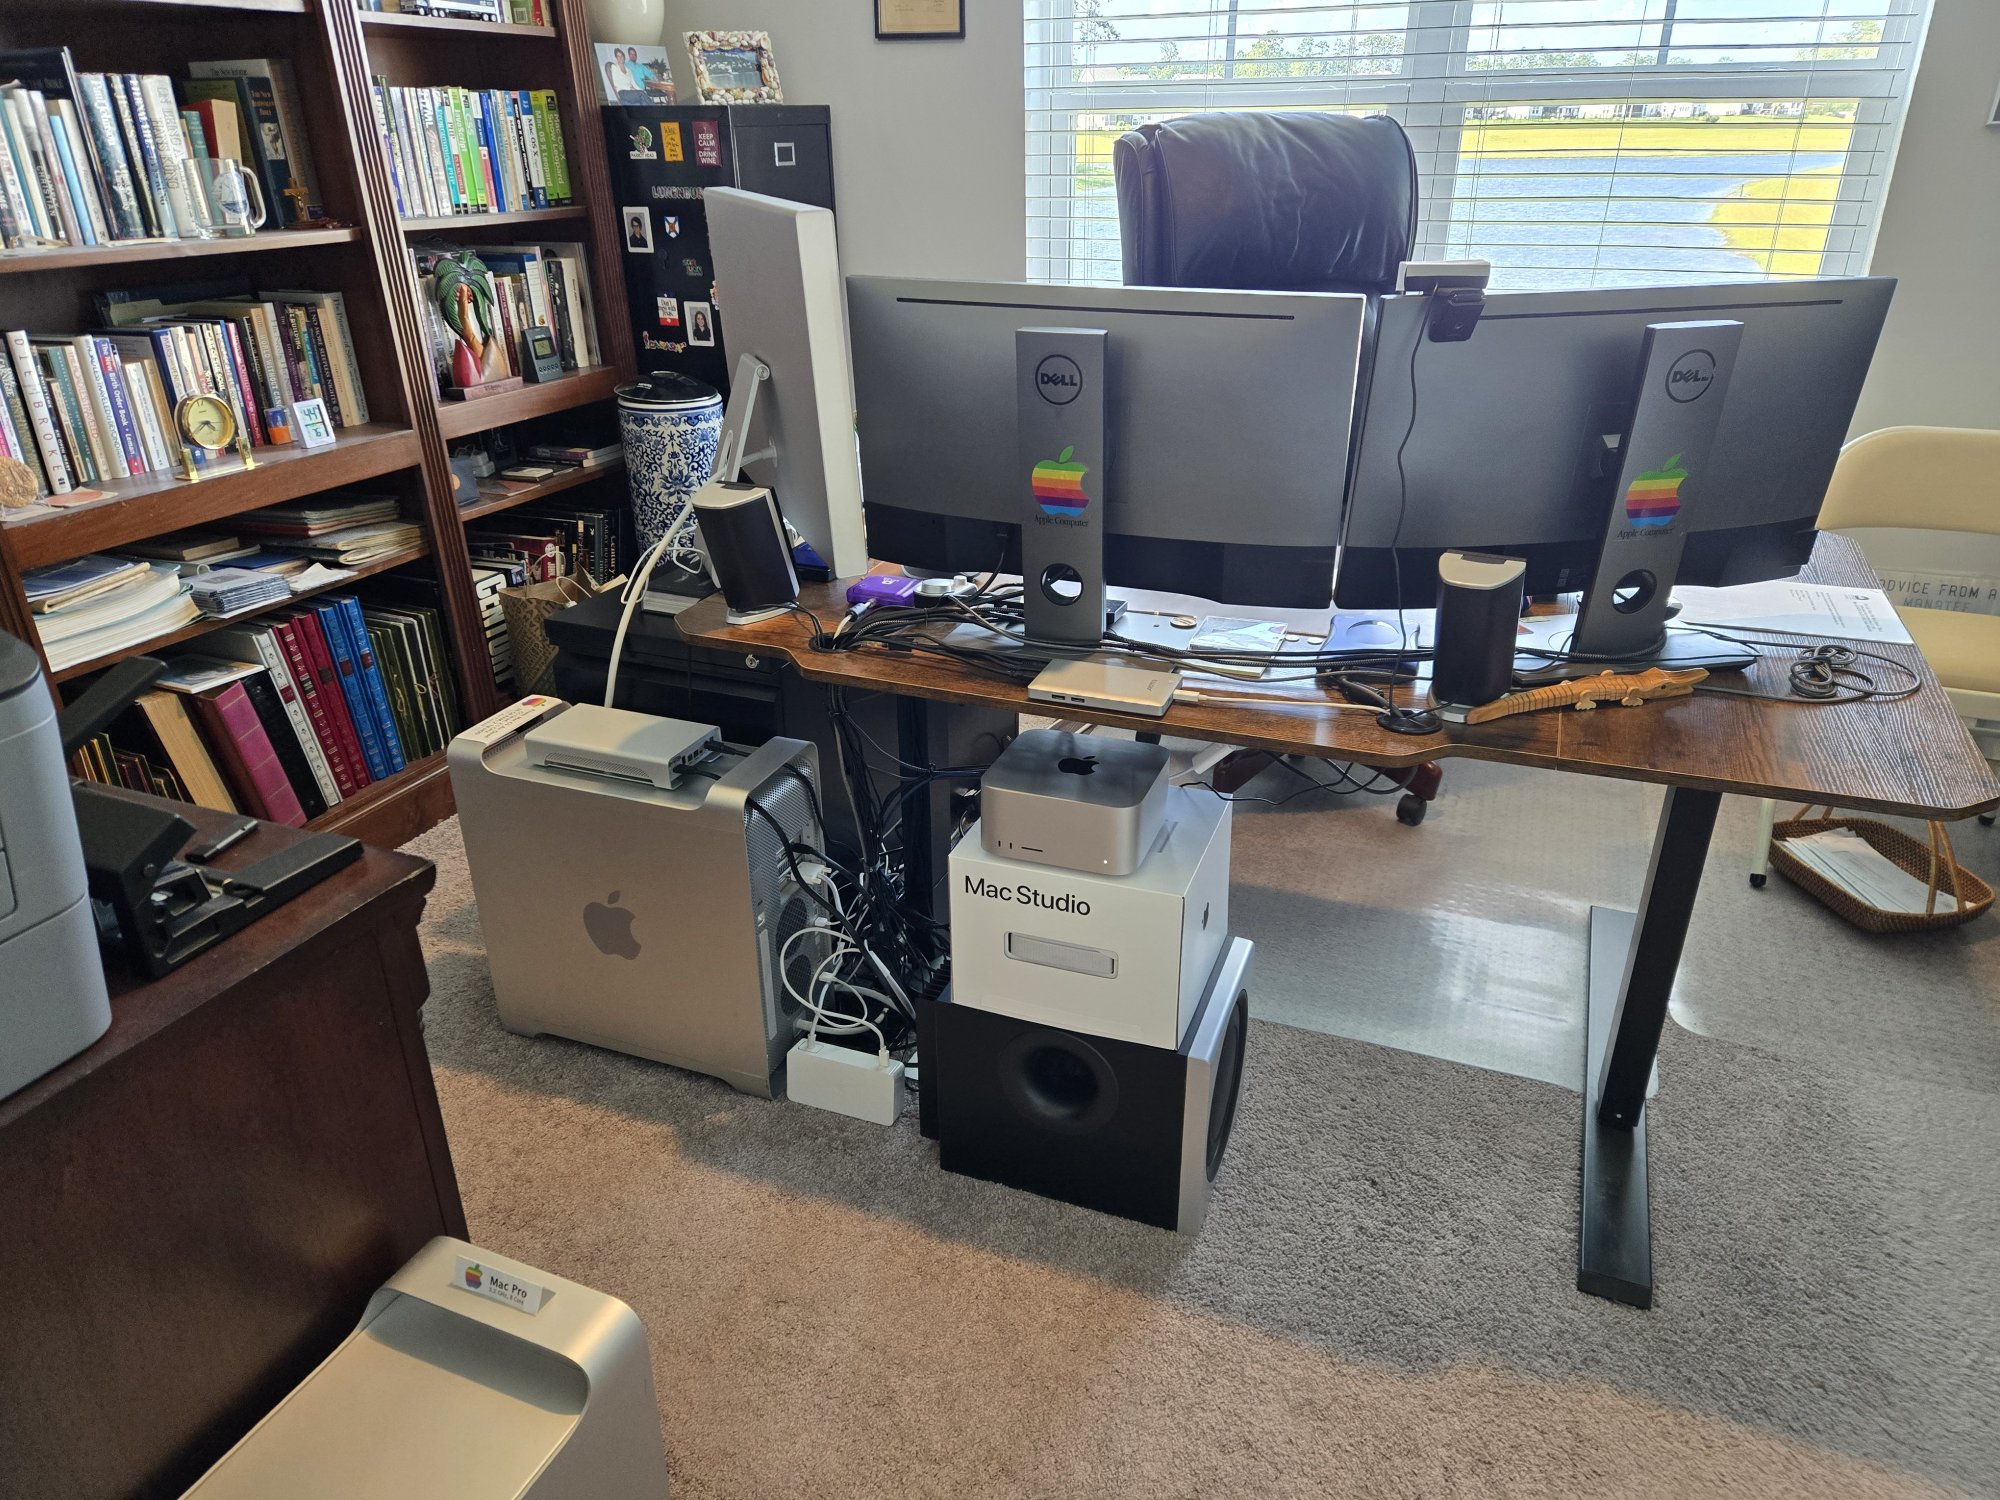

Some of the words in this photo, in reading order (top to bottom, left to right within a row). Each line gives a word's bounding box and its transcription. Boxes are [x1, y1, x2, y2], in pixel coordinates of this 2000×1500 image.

[90, 79, 106, 103] Paul
[94, 101, 116, 146] Johnson
[375, 95, 389, 136] UNIX
[466, 113, 475, 136] CSS
[534, 110, 543, 129] Mac
[553, 114, 562, 134] Mac
[447, 122, 456, 140] PHP
[454, 109, 468, 152] JavaScript
[540, 130, 546, 143] OS
[437, 109, 451, 166] Programming
[447, 168, 456, 185] PHP
[512, 136, 517, 146] OS
[530, 137, 537, 149] OS
[548, 114, 557, 142] Snow
[553, 144, 565, 184] Leopard
[558, 136, 564, 149] OS
[698, 139, 715, 147] CALM
[560, 152, 566, 161] X
[698, 150, 717, 158] DRINK
[700, 157, 717, 165] WINE
[542, 153, 553, 187] Leopard
[35, 165, 56, 216] CHRISTIAN
[652, 186, 705, 200] LUNENBUR
[333, 298, 341, 310] The
[288, 309, 301, 350] REBUILDING
[311, 314, 318, 326] NO
[336, 312, 347, 338] Promise
[314, 327, 323, 346] MORE
[344, 340, 350, 348] of
[101, 342, 109, 355] The
[105, 356, 114, 372] New
[162, 337, 172, 358] MARS
[171, 367, 182, 389] VENUS
[319, 348, 330, 378] SLEEPLESS
[345, 349, 354, 369] Sleep
[0, 358, 15, 397] CARNEGIE
[109, 372, 119, 389] Birth
[260, 335, 270, 358] WORLD
[266, 360, 277, 389] WITHOUT
[273, 391, 283, 409] CANC
[289, 358, 299, 387] LANGUAGES
[1040, 372, 1078, 387] DELL
[216, 374, 225, 391] SOUL
[327, 379, 336, 404] NIGHTS
[113, 389, 122, 408] Order
[82, 402, 99, 439] TRAVELED
[96, 382, 111, 416] TRAVELED
[107, 421, 121, 449] BEYOND
[118, 408, 127, 427] Book
[33, 401, 63, 472] BROKE
[62, 455, 71, 472] HEART
[1034, 514, 1053, 526] Apple
[1054, 517, 1089, 529] Computer
[1617, 529, 1639, 540] Apple
[1639, 527, 1674, 538] Computer
[1938, 584, 1980, 599] FROM
[1988, 588, 1998, 601] A
[475, 573, 513, 684] CENTURY
[964, 875, 1012, 902] Mac
[1015, 885, 1091, 916] Studio
[490, 1276, 509, 1291] Mac
[512, 1284, 528, 1299] Pro
[513, 1295, 524, 1305] Core
